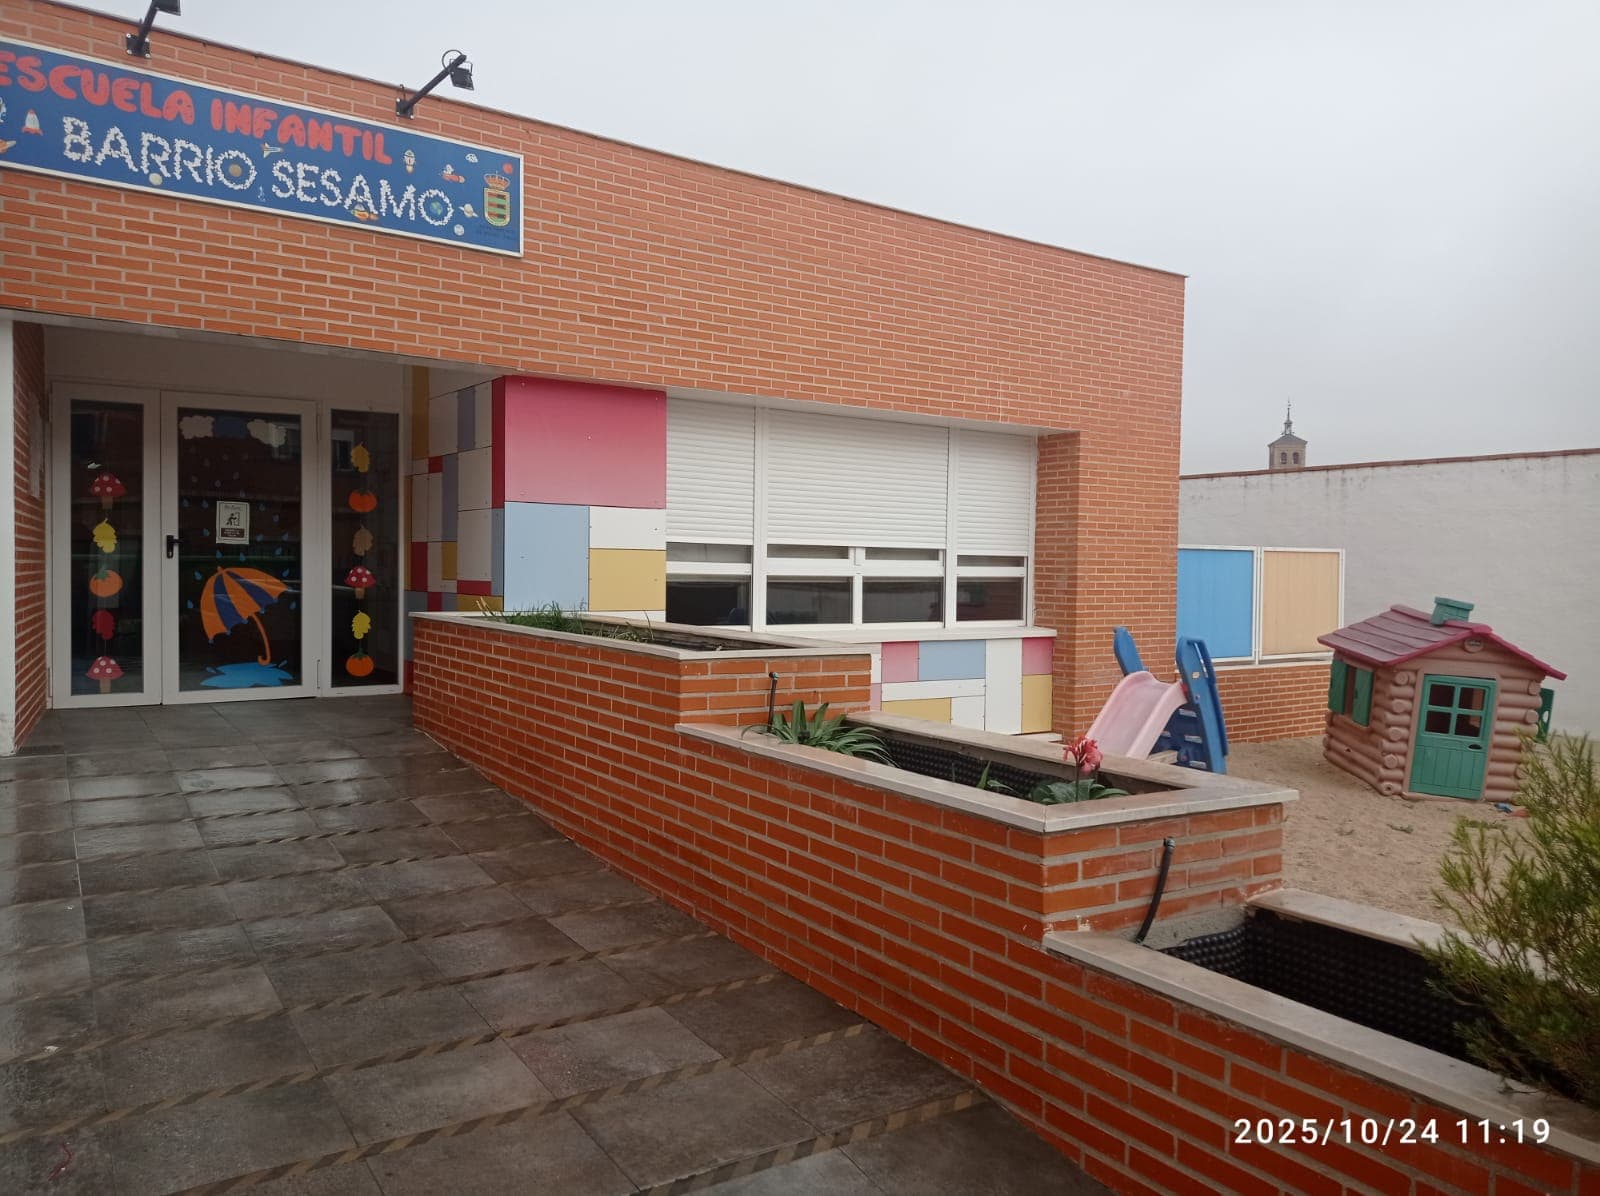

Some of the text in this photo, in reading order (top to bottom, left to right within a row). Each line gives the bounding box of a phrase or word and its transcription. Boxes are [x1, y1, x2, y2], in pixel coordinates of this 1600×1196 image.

[62, 115, 455, 227] BARRIO SESAMO
[210, 98, 393, 165] INFANTIL
